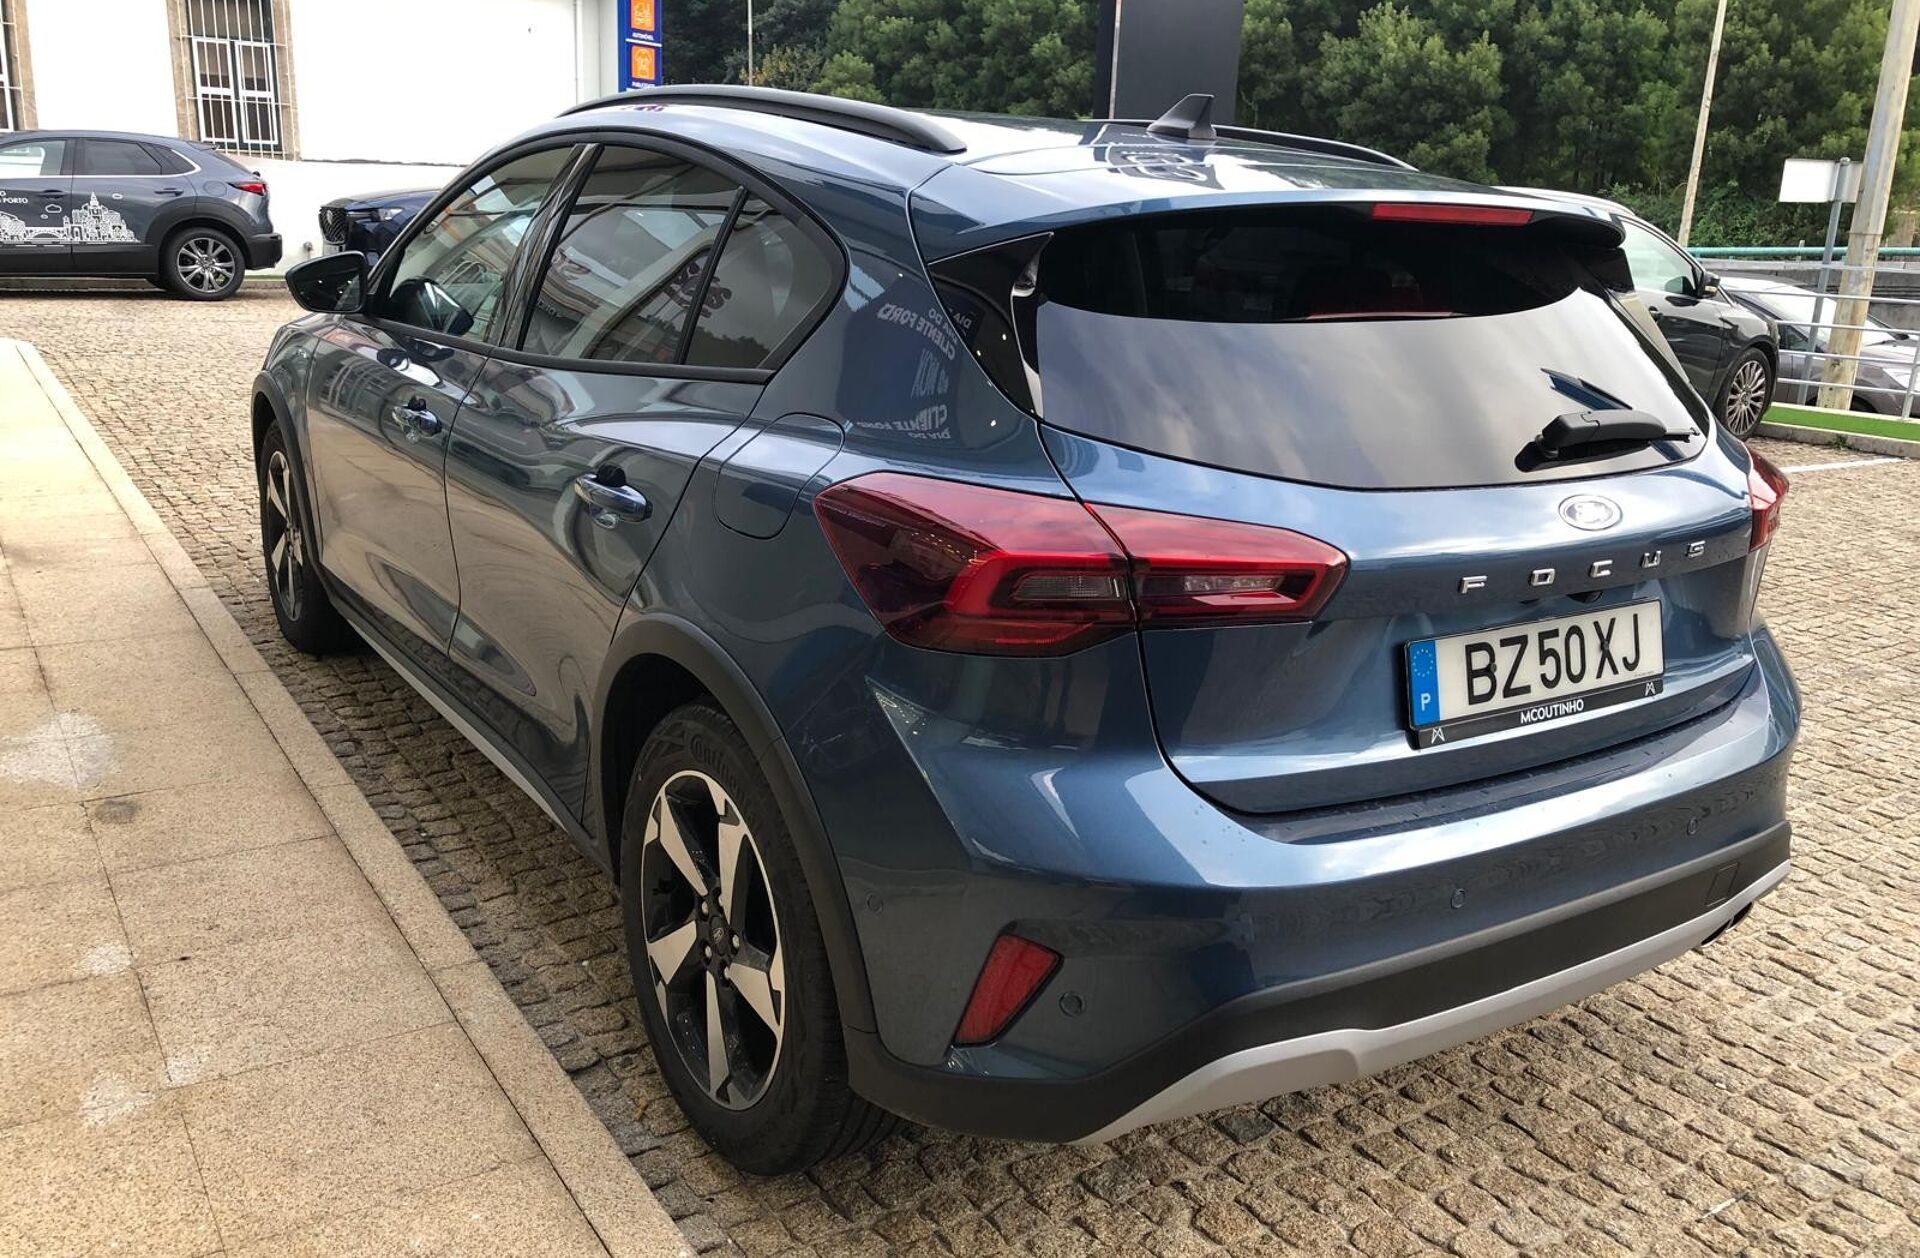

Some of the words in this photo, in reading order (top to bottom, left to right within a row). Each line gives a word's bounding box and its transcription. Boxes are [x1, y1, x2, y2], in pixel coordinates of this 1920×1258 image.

[1459, 540, 1706, 594] FOCUS
[1465, 613, 1640, 706] BZ50XJ
[1420, 692, 1431, 711] P
[1520, 698, 1584, 724] MCOUTINHO
